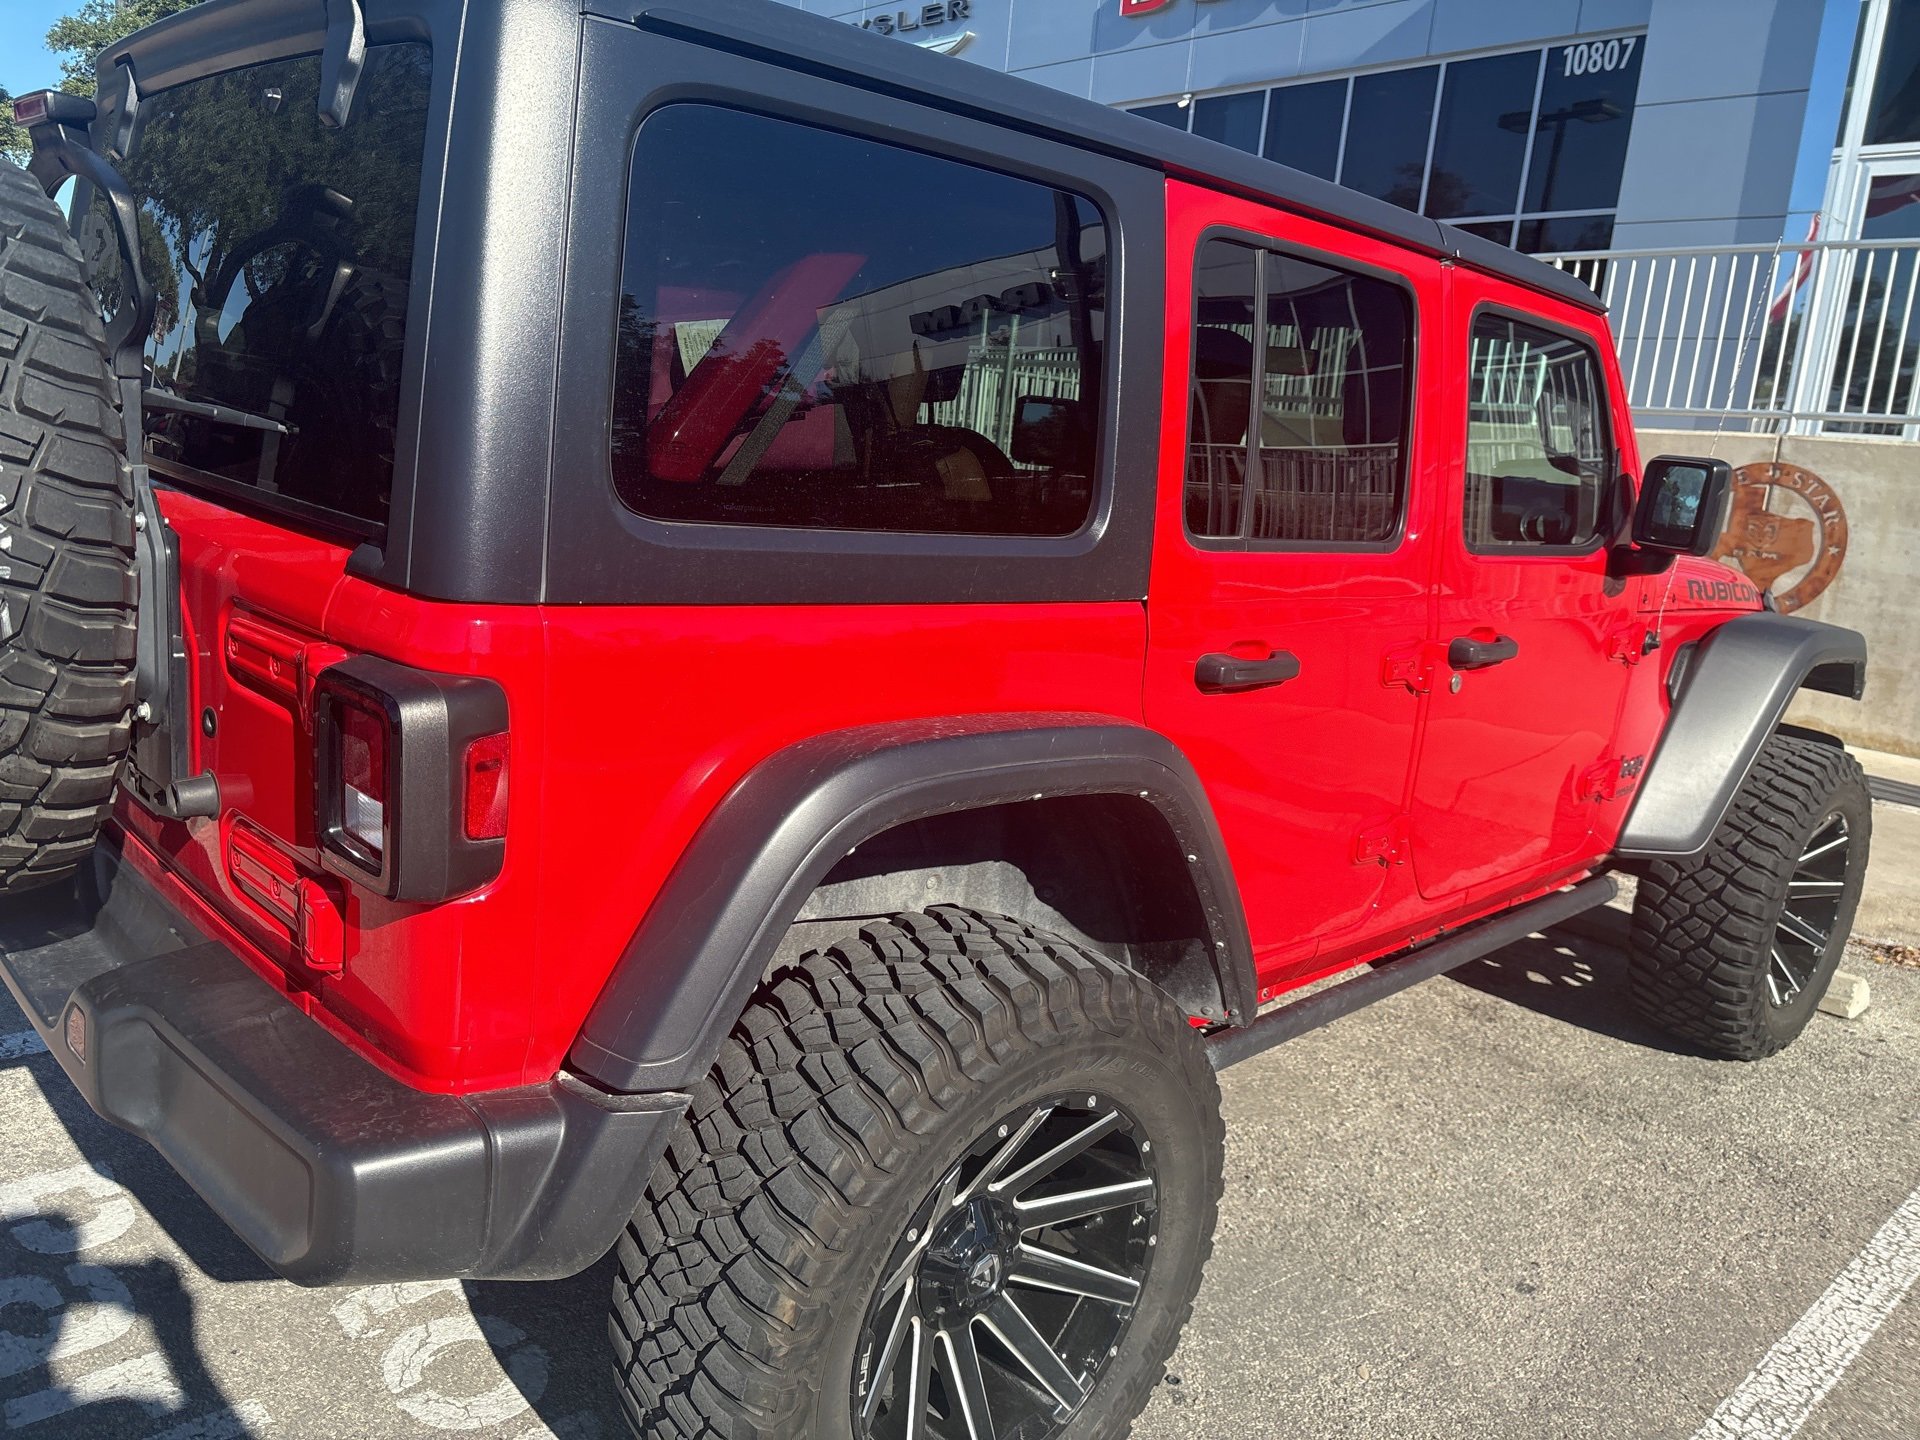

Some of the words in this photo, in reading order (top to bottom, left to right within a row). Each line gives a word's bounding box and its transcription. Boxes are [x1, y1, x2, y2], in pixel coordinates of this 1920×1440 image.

[1563, 38, 1637, 77] 10807
[1791, 471, 1841, 527] STAR
[1687, 579, 1762, 602] RUBICON
[858, 1342, 872, 1397] FUEL
